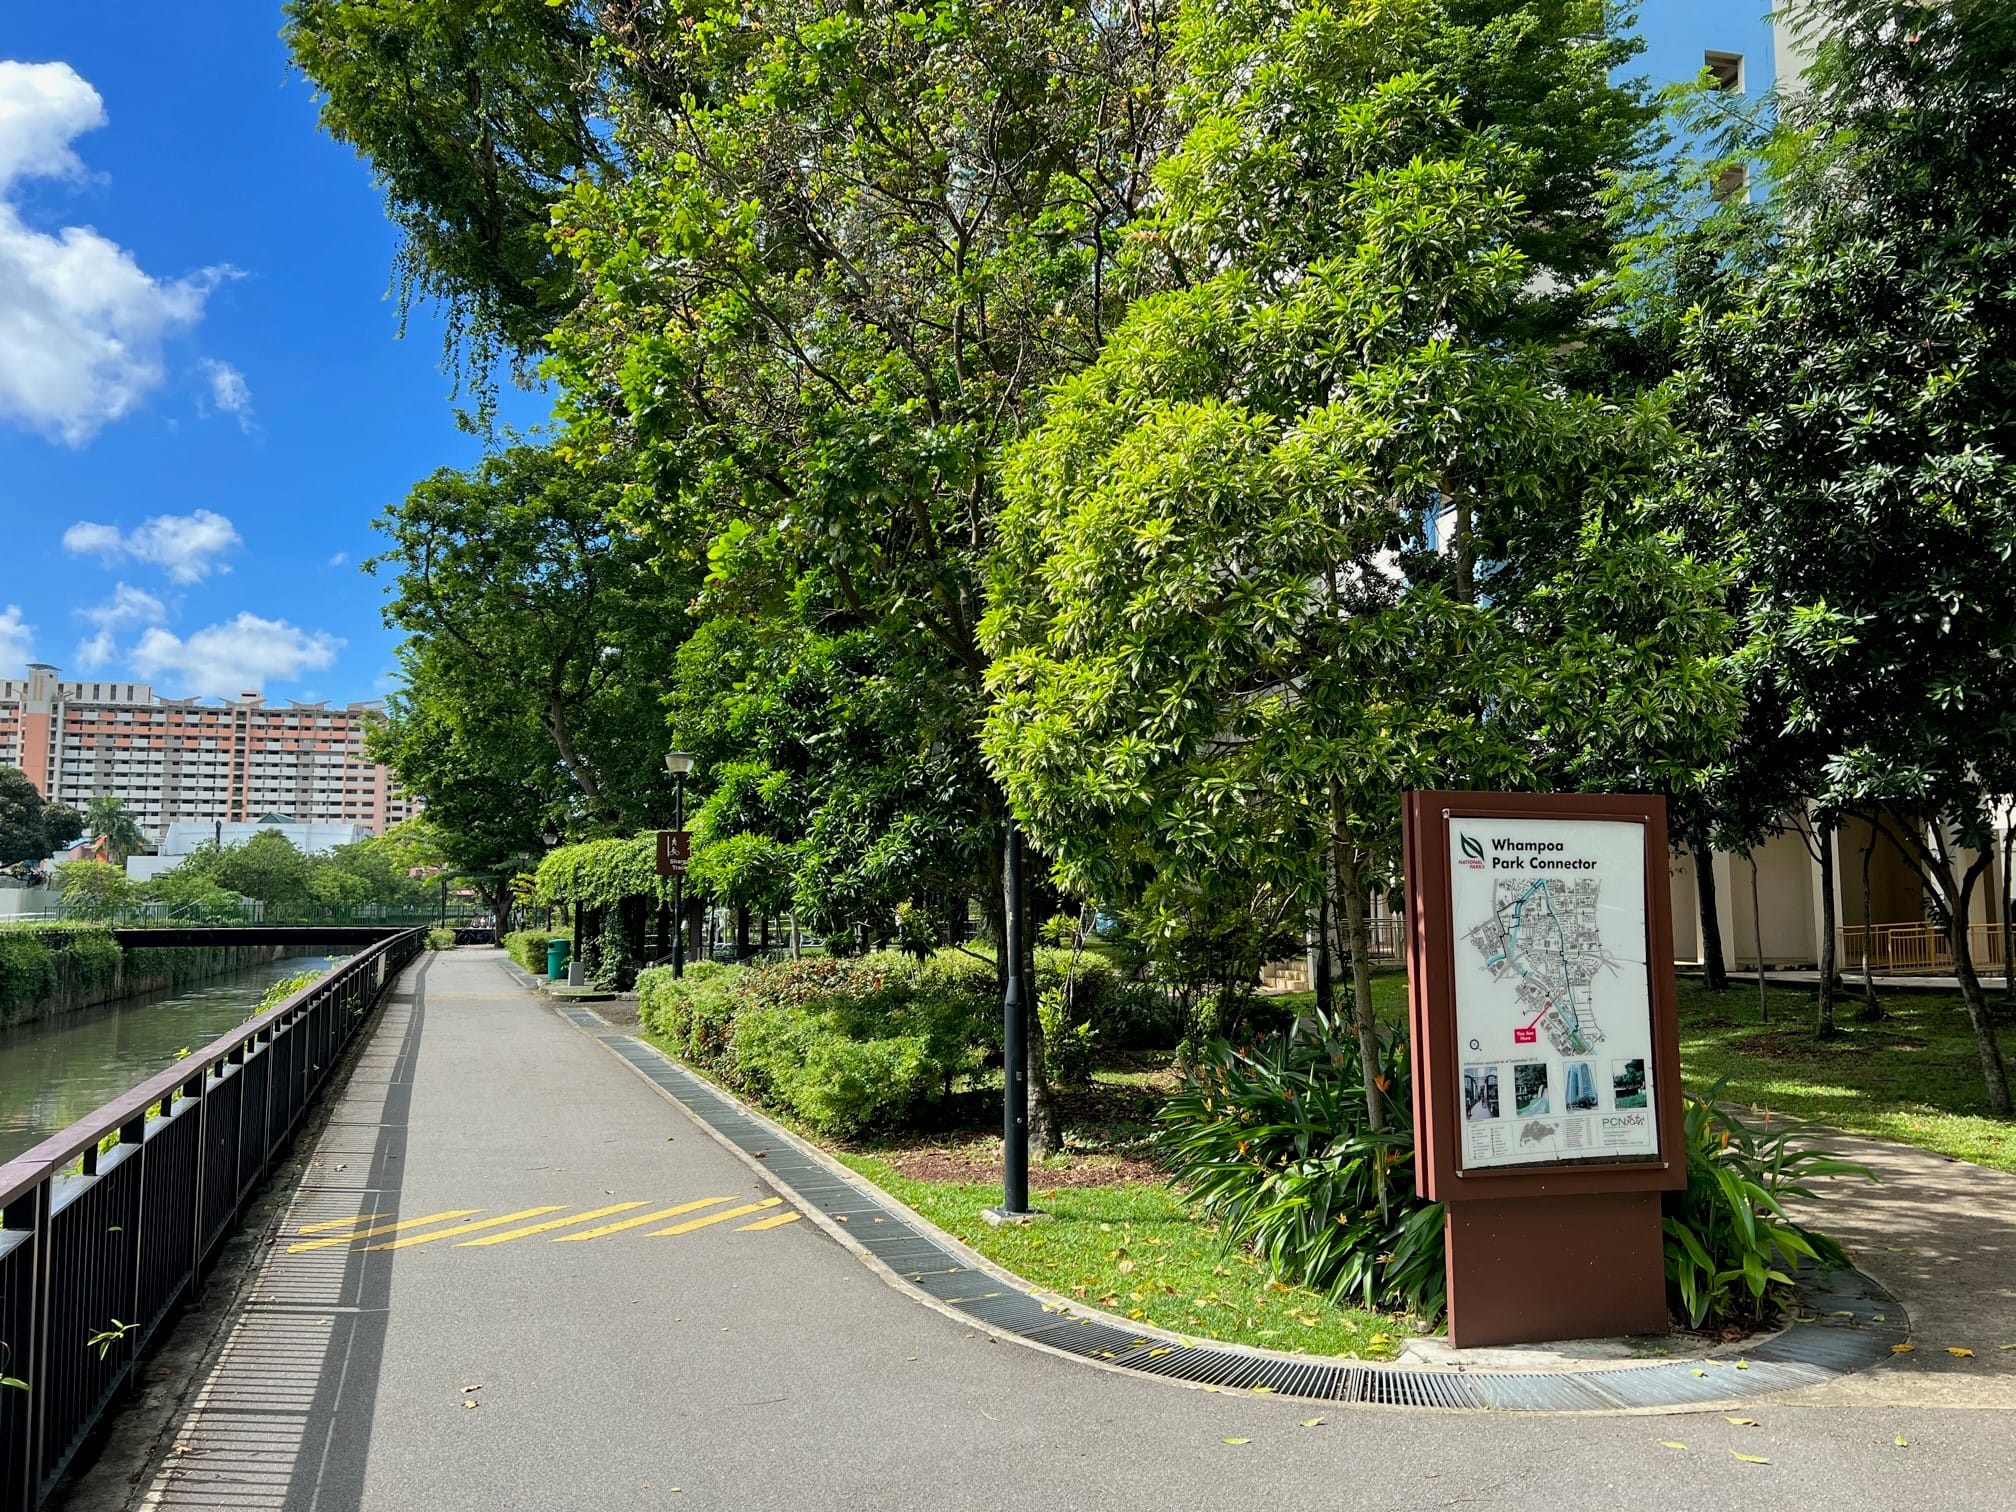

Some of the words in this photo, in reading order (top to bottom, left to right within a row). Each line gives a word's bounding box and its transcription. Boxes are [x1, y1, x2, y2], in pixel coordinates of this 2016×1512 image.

[1491, 838, 1564, 854] Whampoa
[1492, 856, 1525, 869] Park
[1530, 857, 1597, 869] Connector
